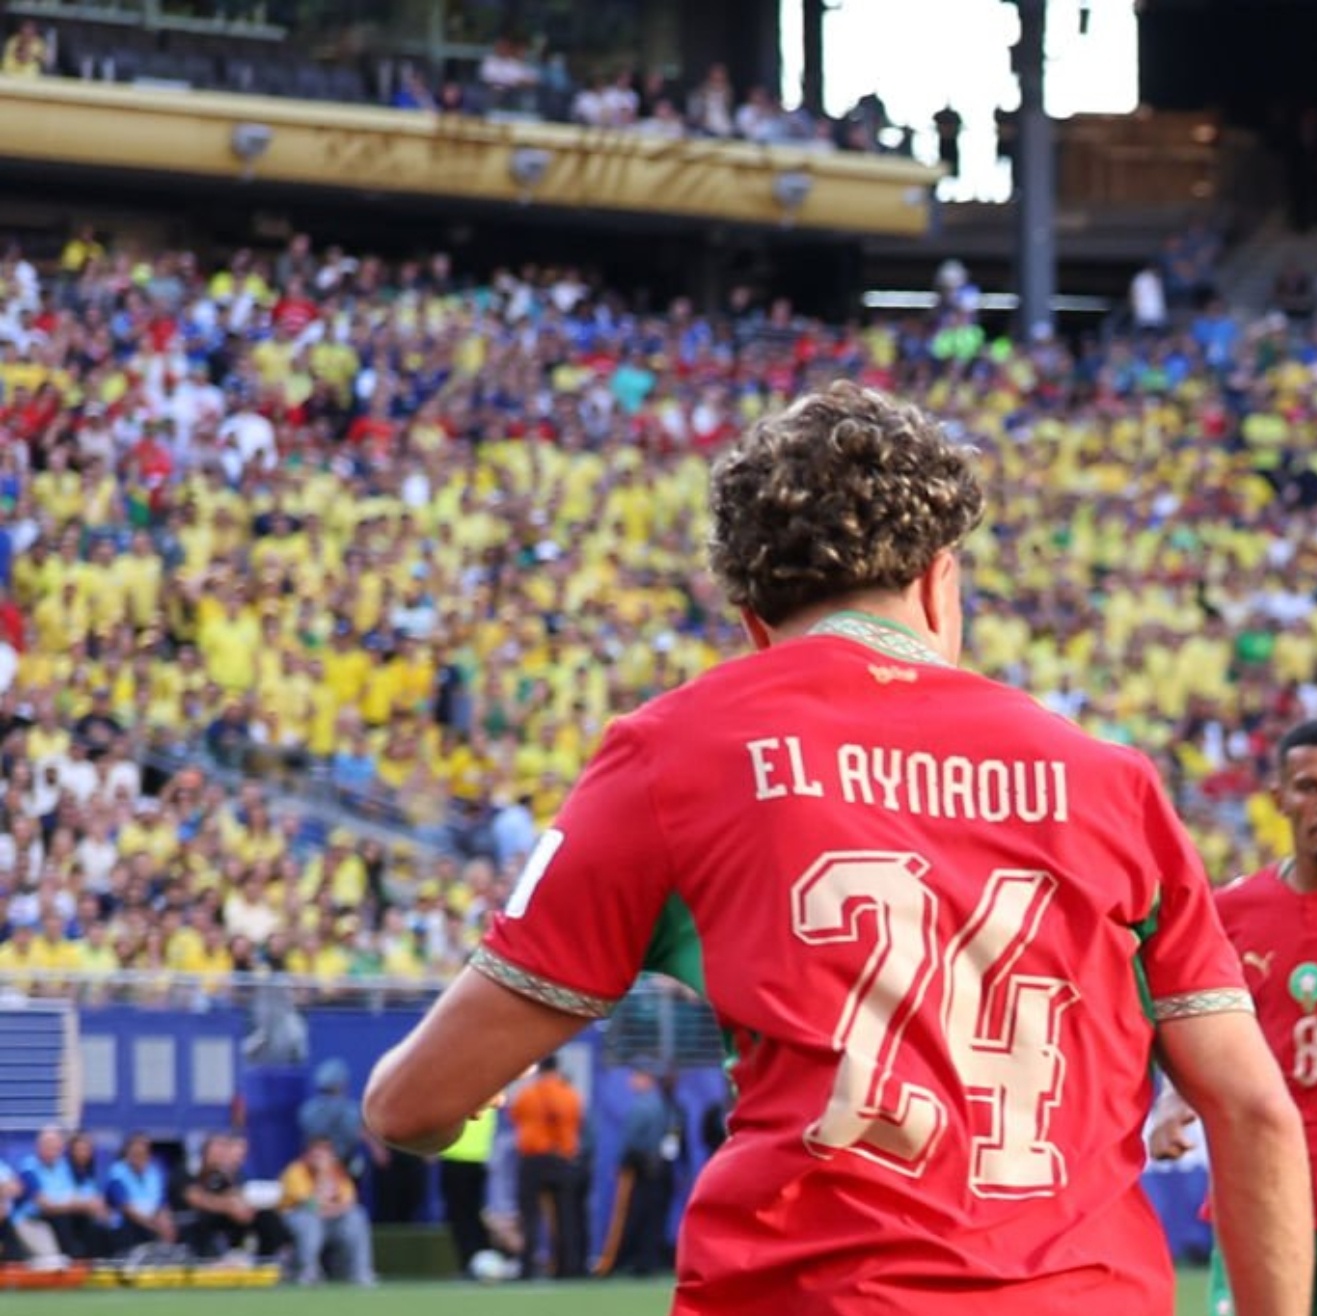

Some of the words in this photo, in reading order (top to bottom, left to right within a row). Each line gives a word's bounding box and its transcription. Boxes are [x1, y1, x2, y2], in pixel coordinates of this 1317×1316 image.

[746, 737, 824, 801] EL
[837, 743, 1069, 823] AYNAOUI
[790, 849, 1082, 1200] 24
